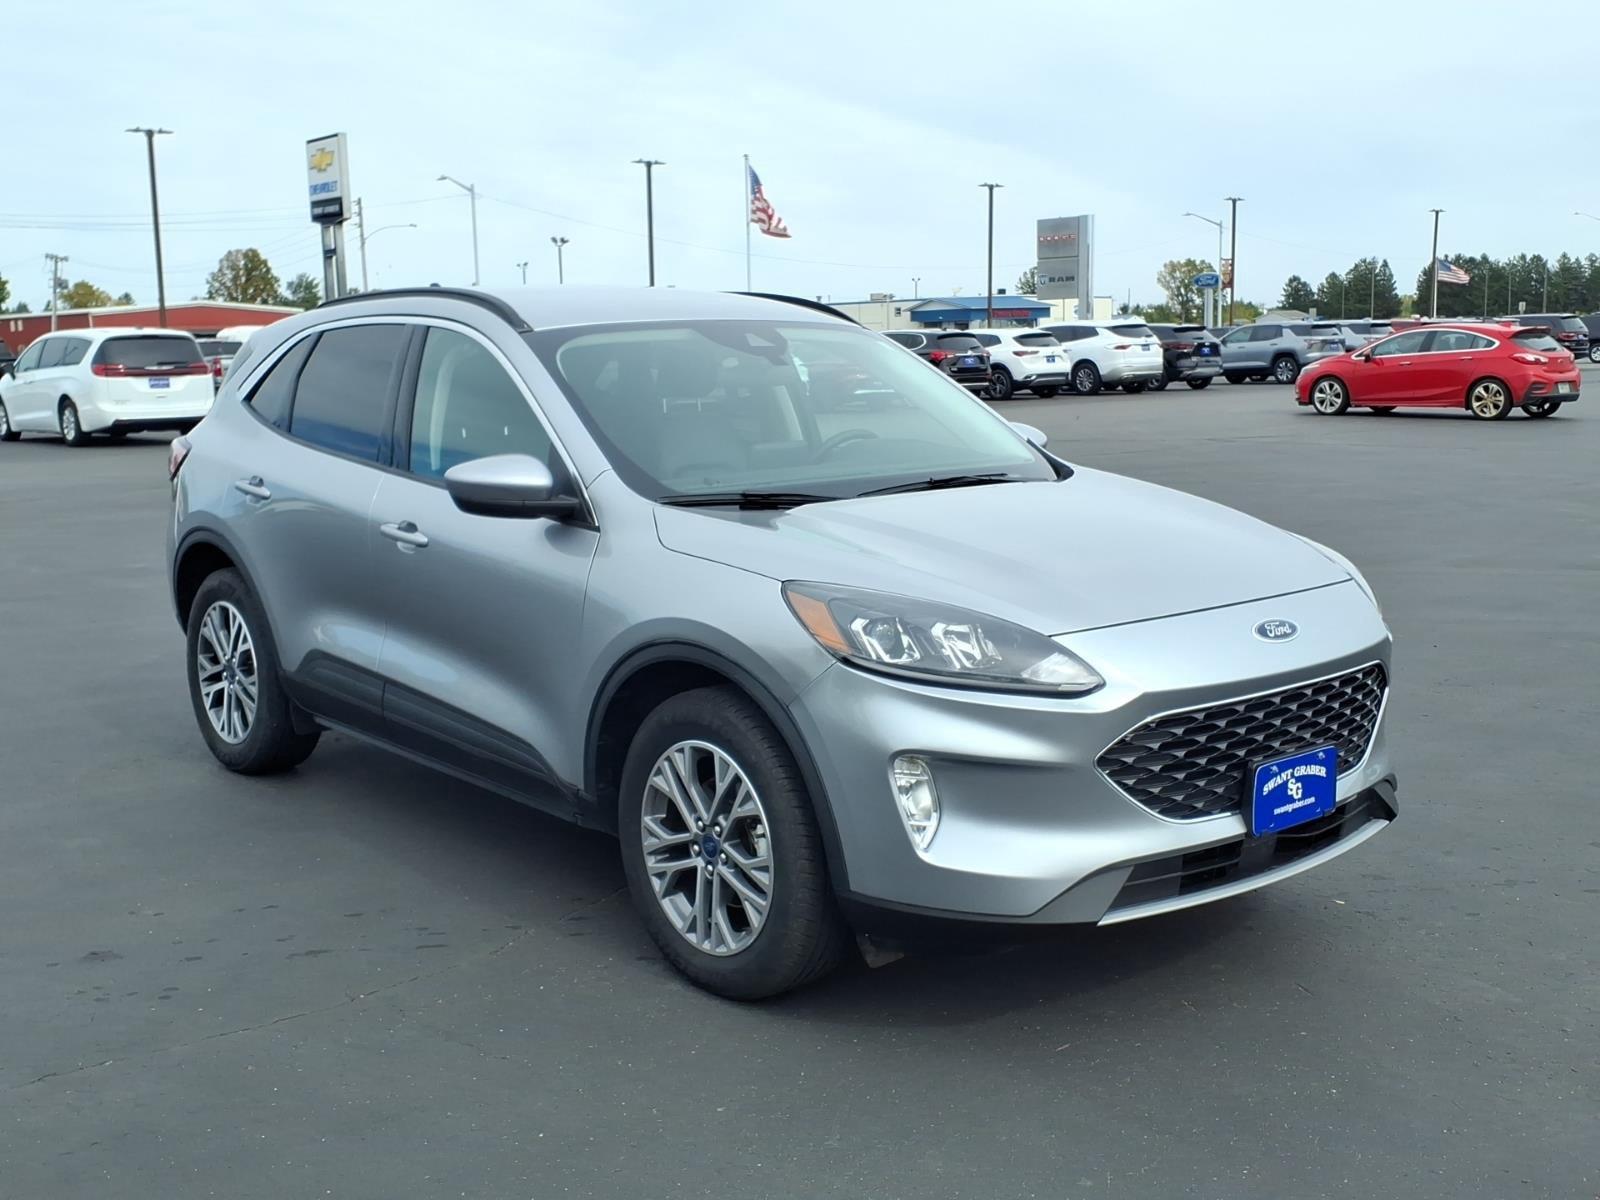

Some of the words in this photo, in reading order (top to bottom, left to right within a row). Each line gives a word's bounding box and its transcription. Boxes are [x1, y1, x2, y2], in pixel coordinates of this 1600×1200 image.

[1264, 621, 1292, 637] Ford
[1263, 769, 1293, 796] SWANT
[1294, 765, 1327, 778] GRABER
